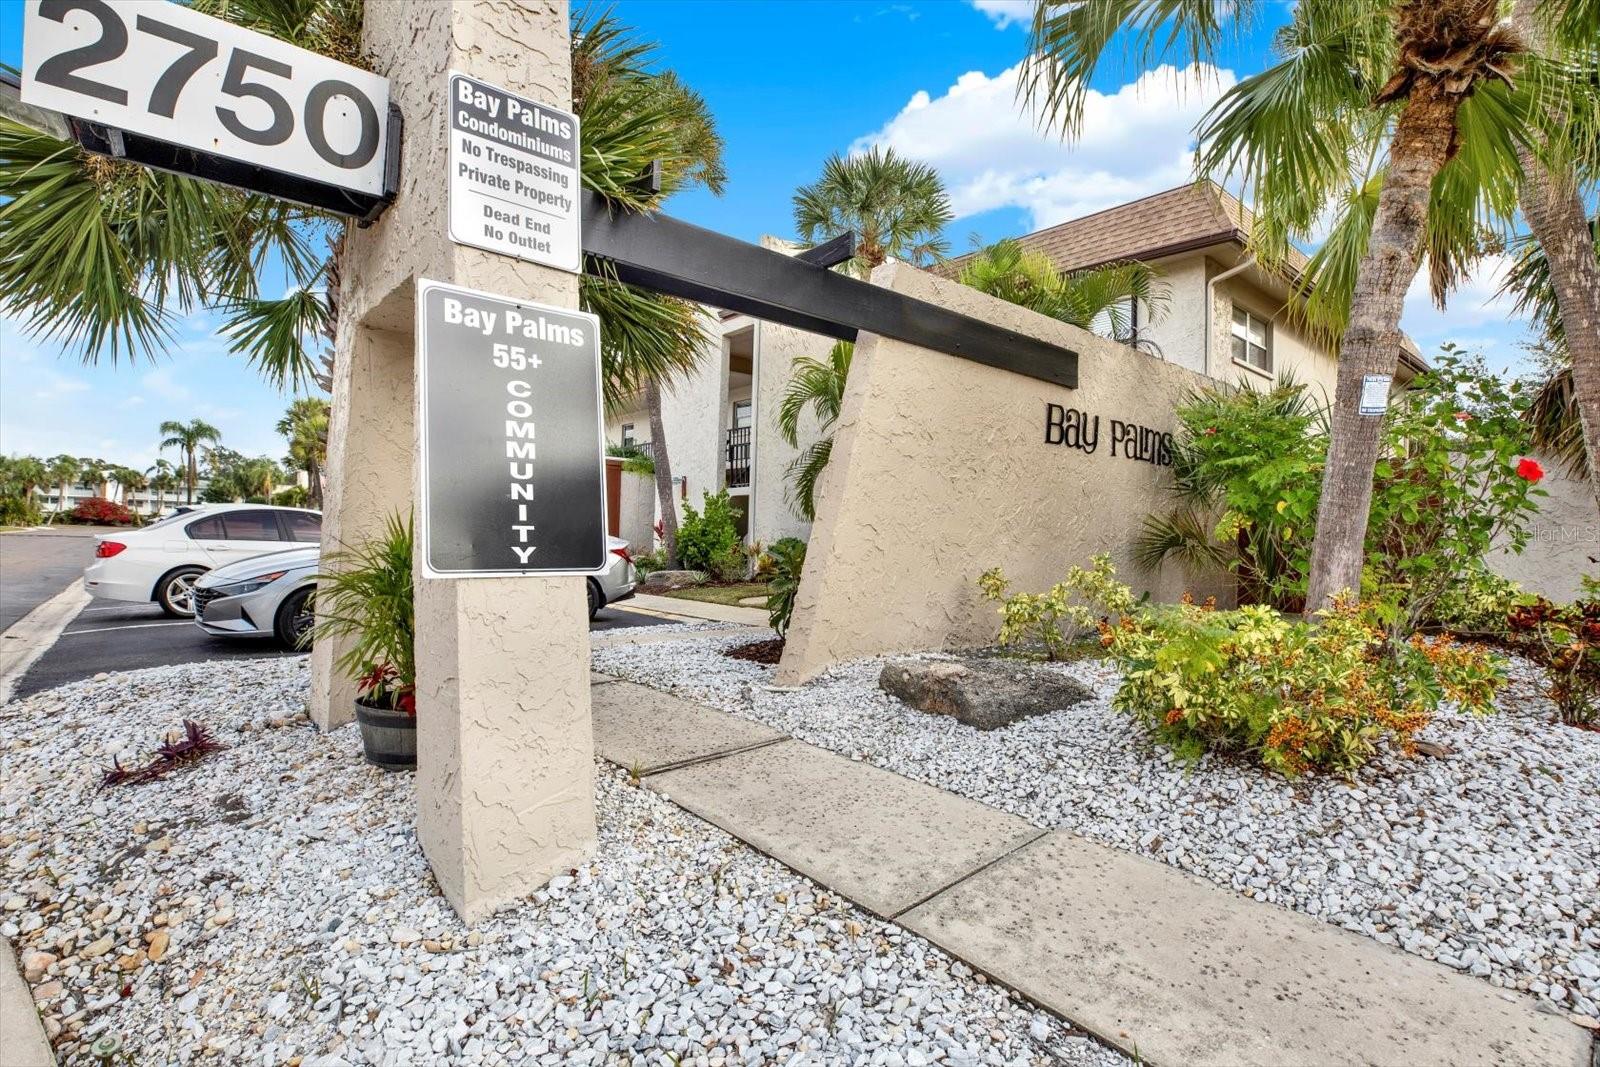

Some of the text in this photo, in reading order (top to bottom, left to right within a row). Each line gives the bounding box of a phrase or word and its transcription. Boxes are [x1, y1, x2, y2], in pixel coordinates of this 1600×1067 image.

[34, 0, 380, 170] 2750
[458, 80, 571, 139] Bay Palms
[458, 110, 571, 163] Condominiums
[458, 162, 572, 213] Private Property
[462, 138, 569, 188] No Trespassing
[483, 204, 551, 236] Dead End
[484, 224, 552, 255] No Outlet
[444, 298, 585, 347] Bay Palms
[492, 343, 542, 370] 55+
[1045, 402, 1099, 454] Bay
[505, 380, 537, 564] COMMUNITY
